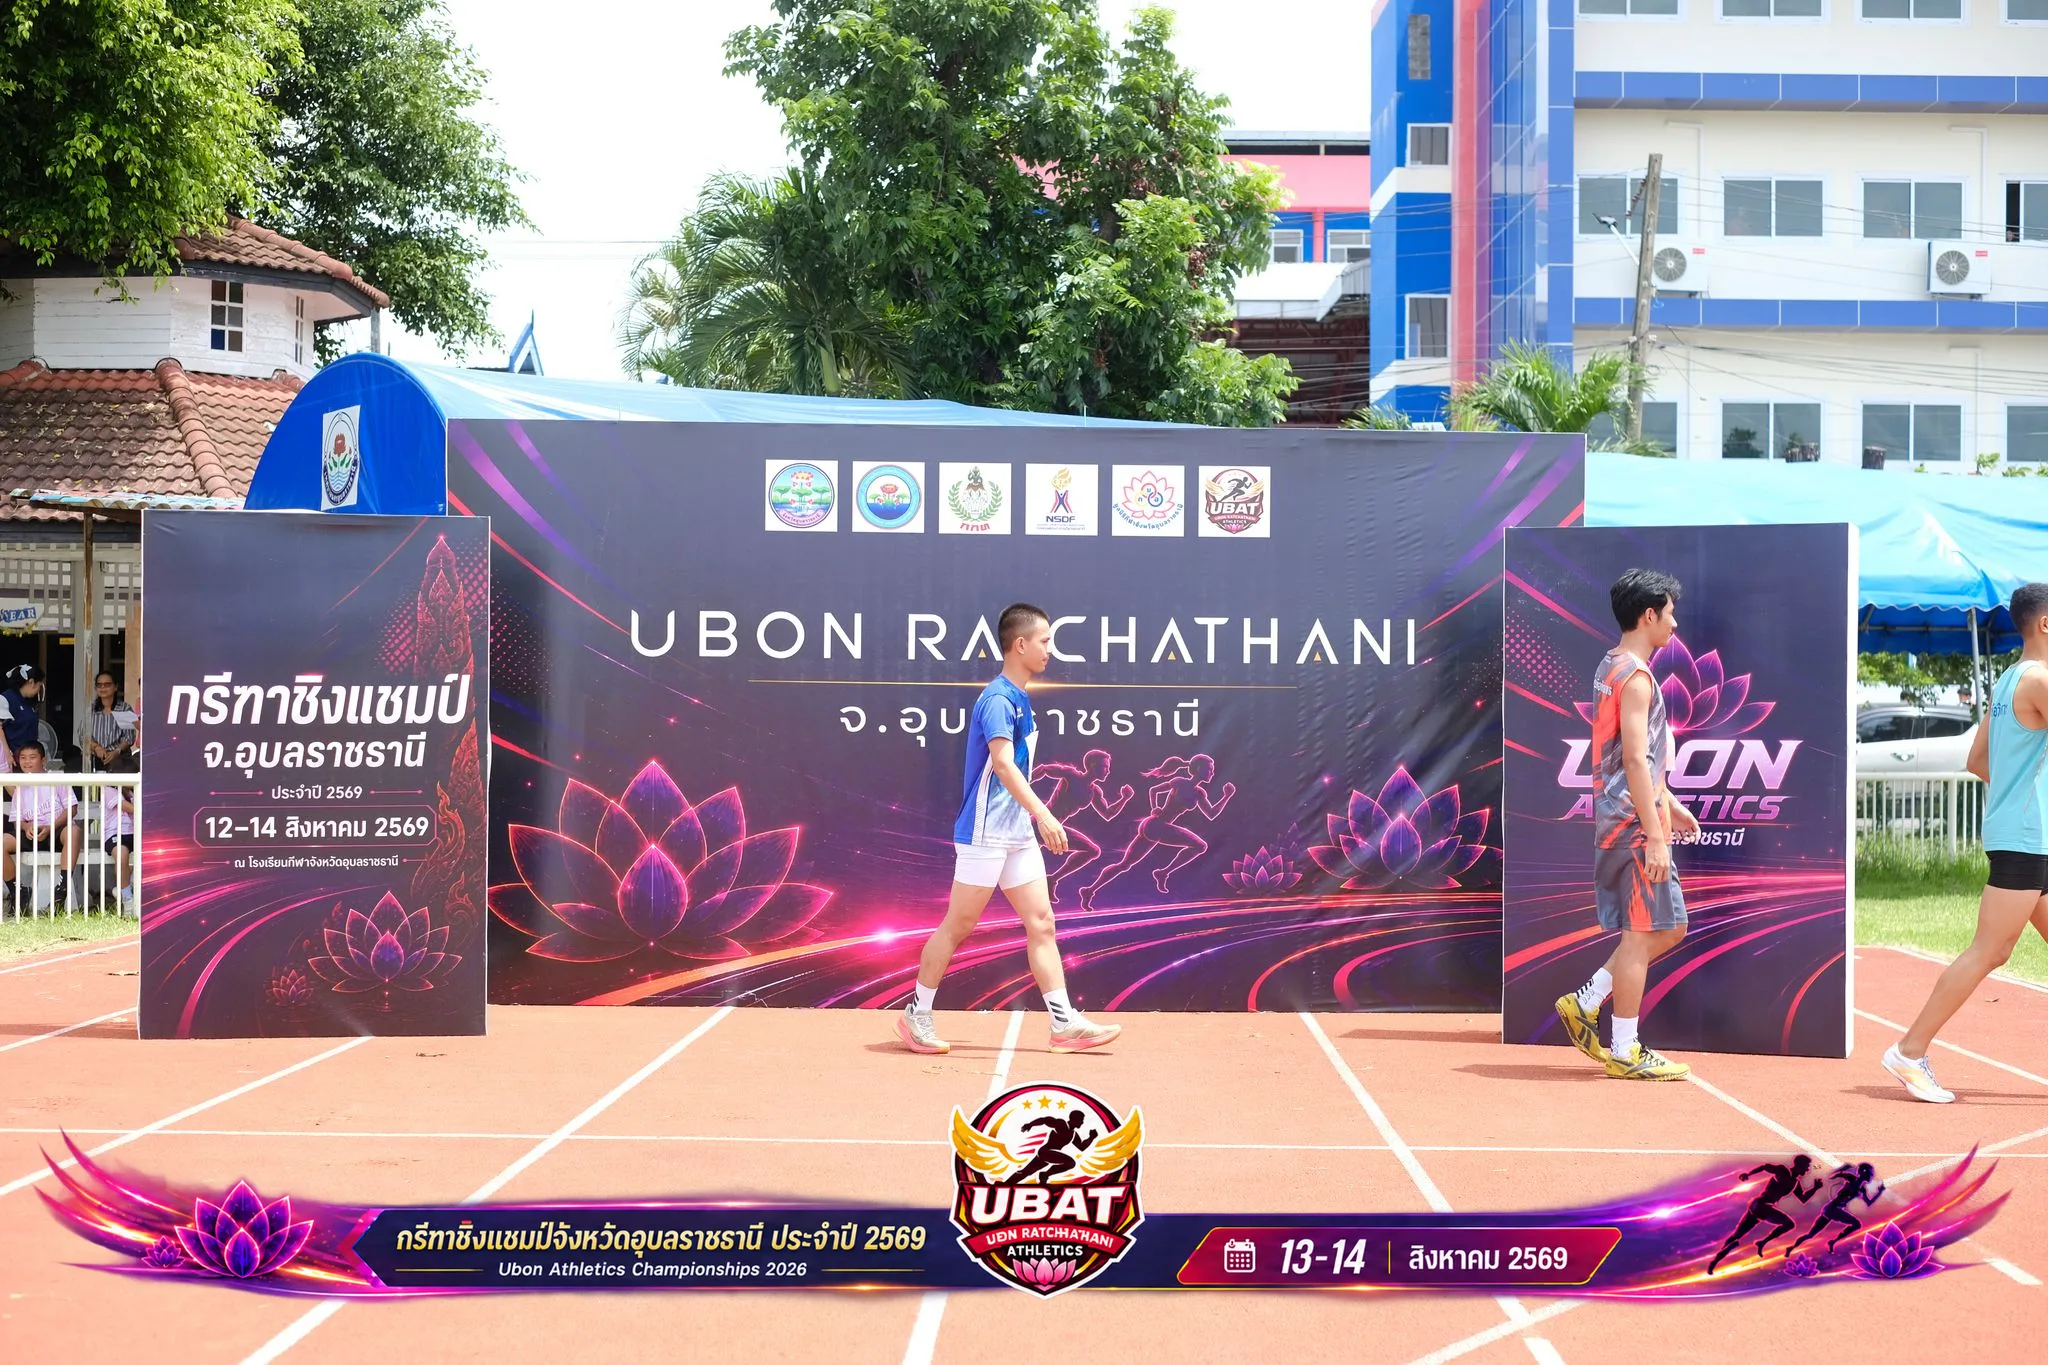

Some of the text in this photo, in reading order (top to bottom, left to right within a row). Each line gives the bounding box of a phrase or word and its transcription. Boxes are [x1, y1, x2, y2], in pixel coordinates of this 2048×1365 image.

[1210, 502, 1260, 515] UBAT
[960, 522, 991, 532] กกท
[1046, 515, 1076, 523] NSDF
[631, 609, 1415, 665] UBON RACHATHANI
[167, 672, 471, 725] กรีฑาชิงแชมป์
[840, 698, 1199, 747] จ.อุบาชธานี
[203, 731, 427, 779] จ.อุบลราชธานี
[271, 784, 363, 800] ประจำปี 2569
[285, 815, 367, 838] สิงหาคม
[374, 816, 429, 837] 2569
[234, 858, 246, 868] ณ
